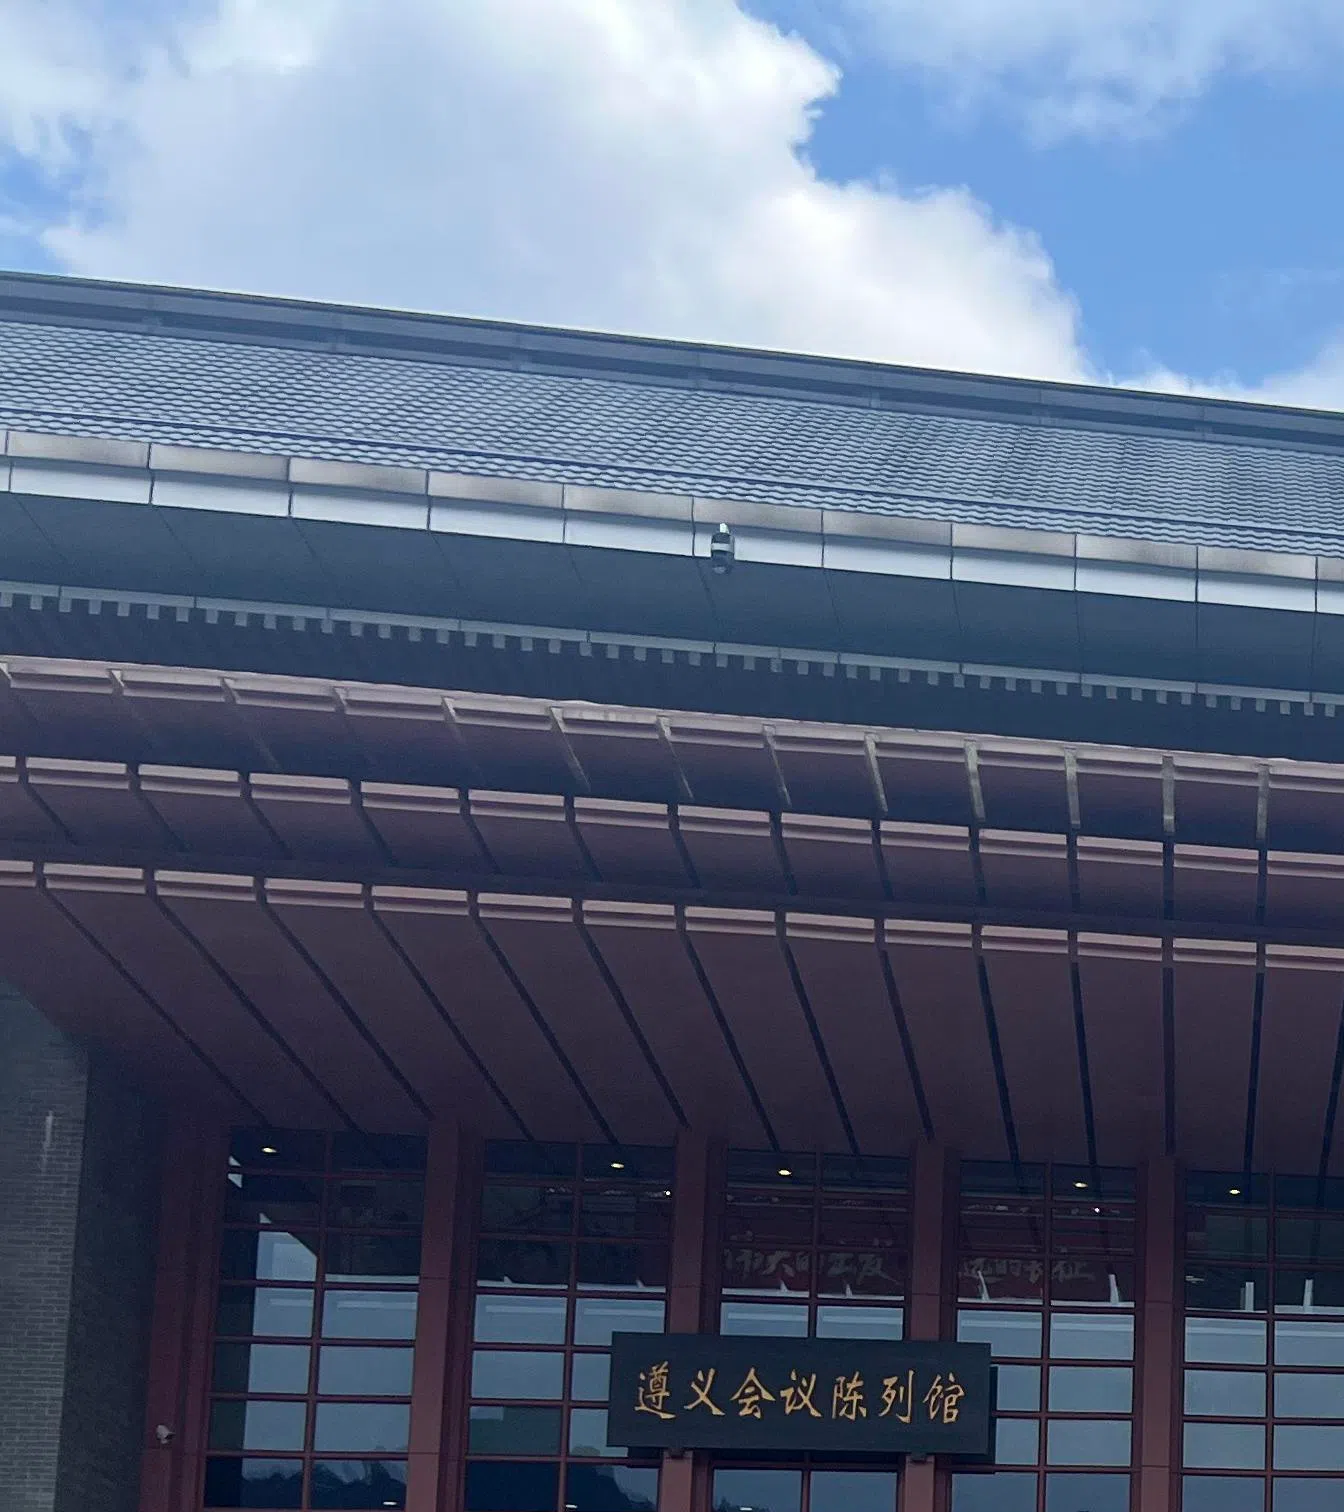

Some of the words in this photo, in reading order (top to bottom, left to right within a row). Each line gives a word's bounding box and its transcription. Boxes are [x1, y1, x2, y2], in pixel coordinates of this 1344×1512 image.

[634, 1360, 966, 1424] 遵义会议陈列馆
